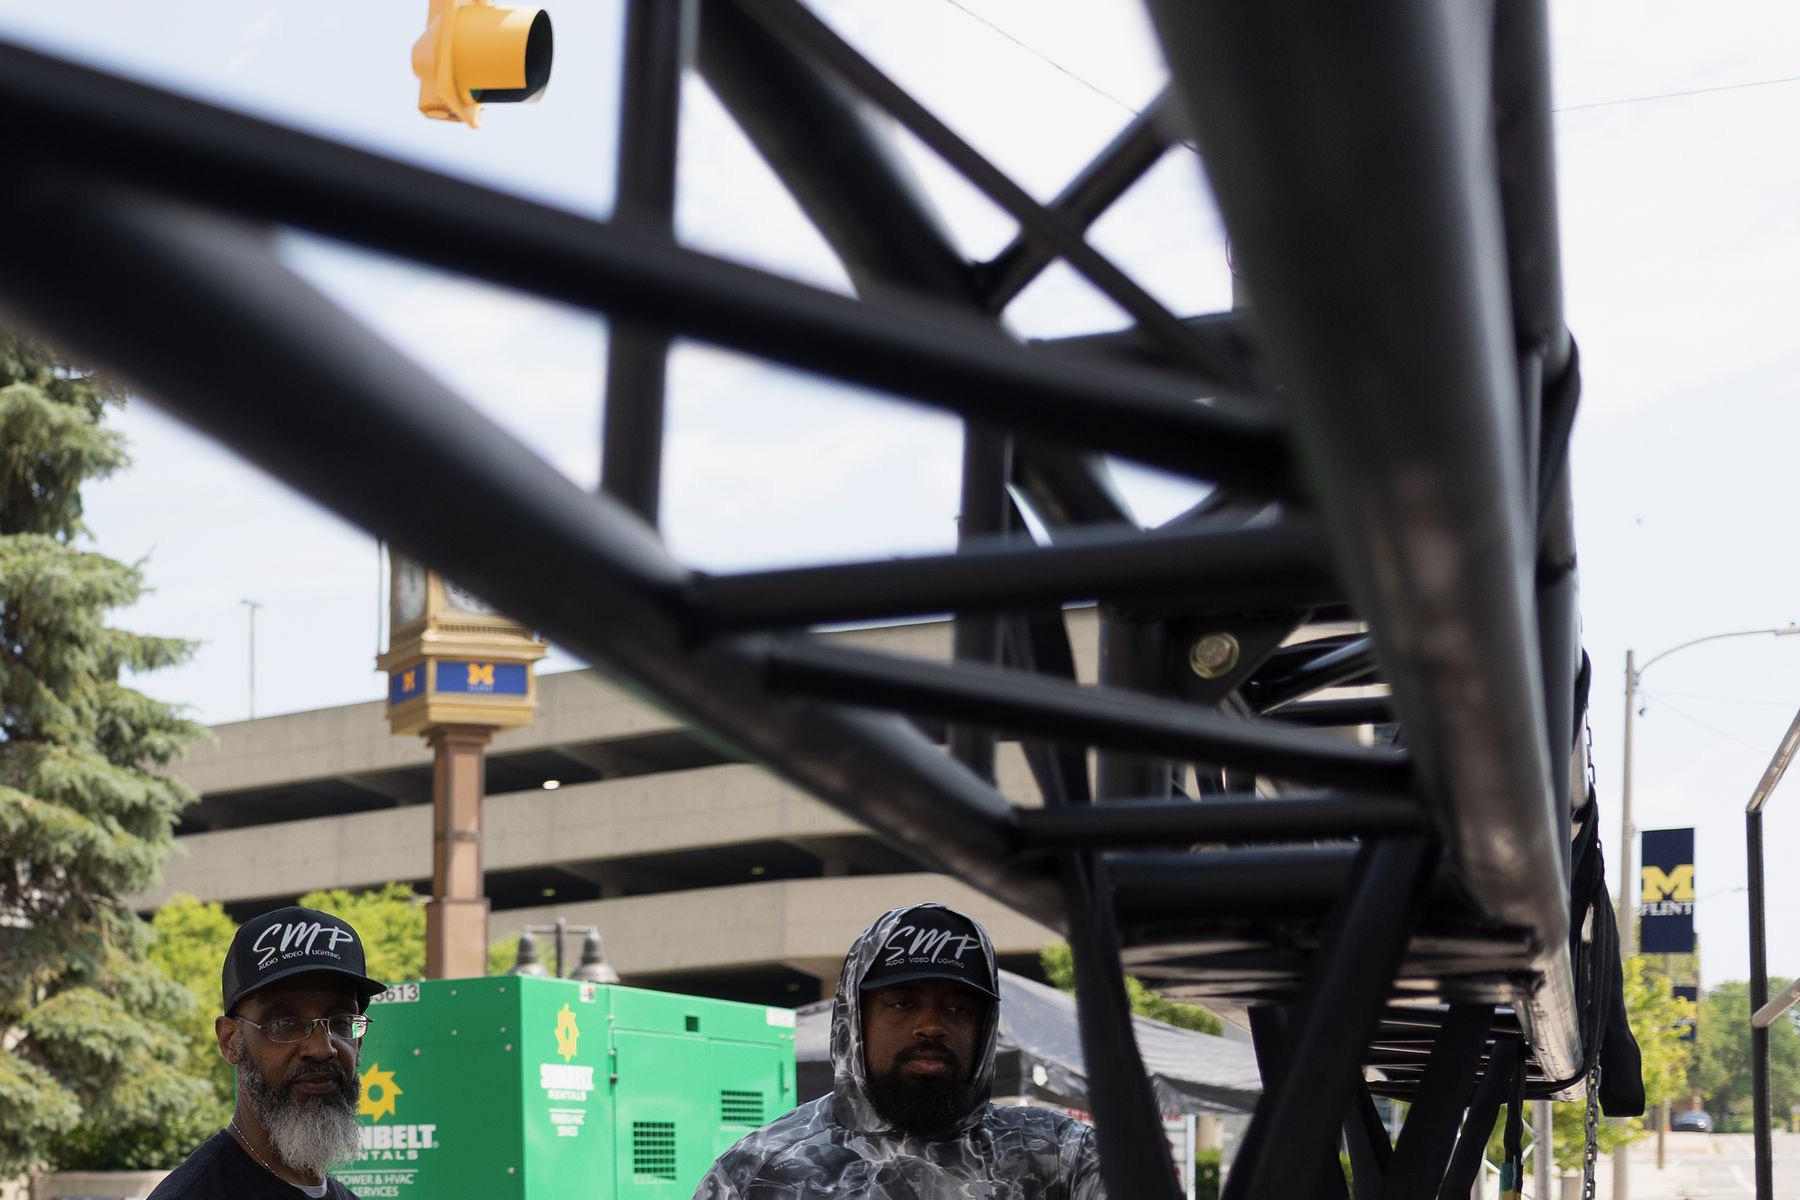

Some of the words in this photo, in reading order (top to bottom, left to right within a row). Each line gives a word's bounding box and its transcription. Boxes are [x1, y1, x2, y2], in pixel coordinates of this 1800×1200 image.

[1641, 865, 1694, 902] M
[1640, 901, 1695, 916] FLINT
[252, 920, 354, 966] SMP
[884, 925, 981, 964] SMP
[258, 957, 279, 971] AUDIO
[281, 950, 304, 961] VIDEO
[312, 949, 341, 960] LIGHTING
[885, 958, 905, 967] AUDIO
[909, 956, 930, 964] VIDEO
[937, 958, 965, 969] LIGHTING
[358, 1125, 437, 1150] NBELT
[357, 1150, 419, 1161] NTALS
[338, 1174, 373, 1186] POWER
[375, 1174, 383, 1185] &
[385, 1173, 414, 1185] HVAC
[352, 1186, 399, 1198] SERVICES
